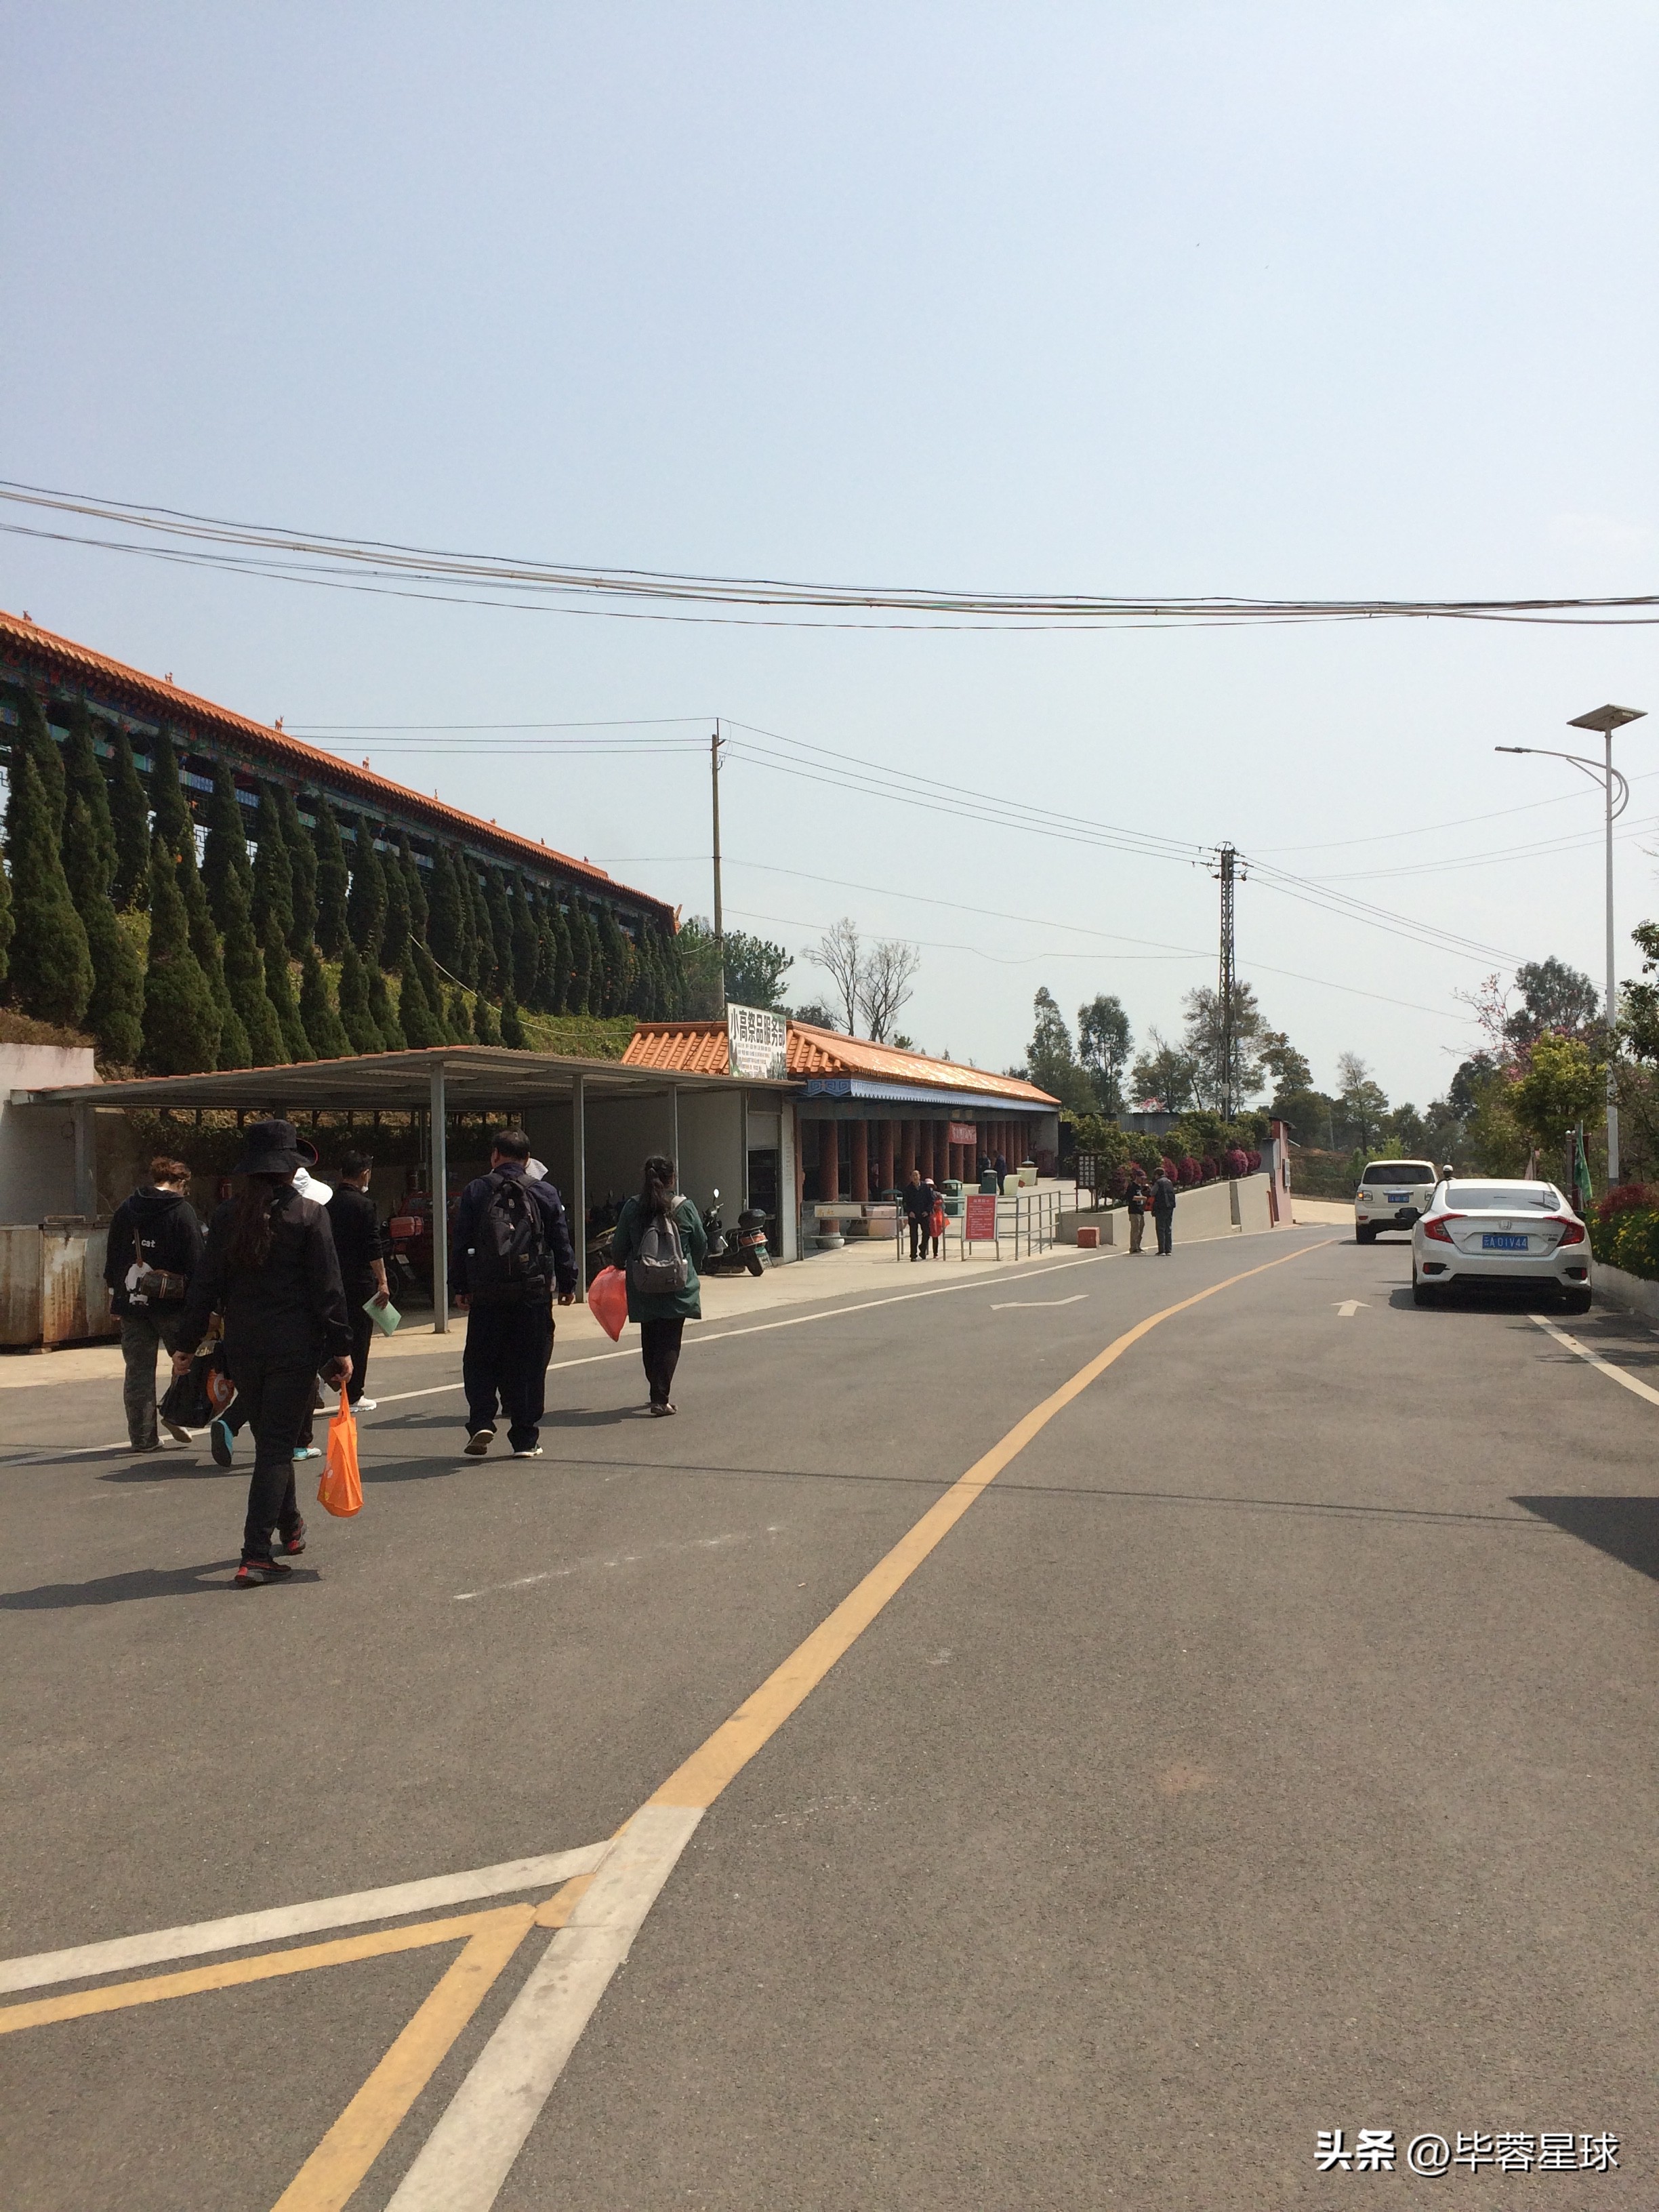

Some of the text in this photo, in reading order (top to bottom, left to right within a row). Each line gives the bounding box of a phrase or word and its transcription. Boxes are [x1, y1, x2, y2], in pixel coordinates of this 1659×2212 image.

[731, 1008, 785, 1048] 小高祭品服务部
